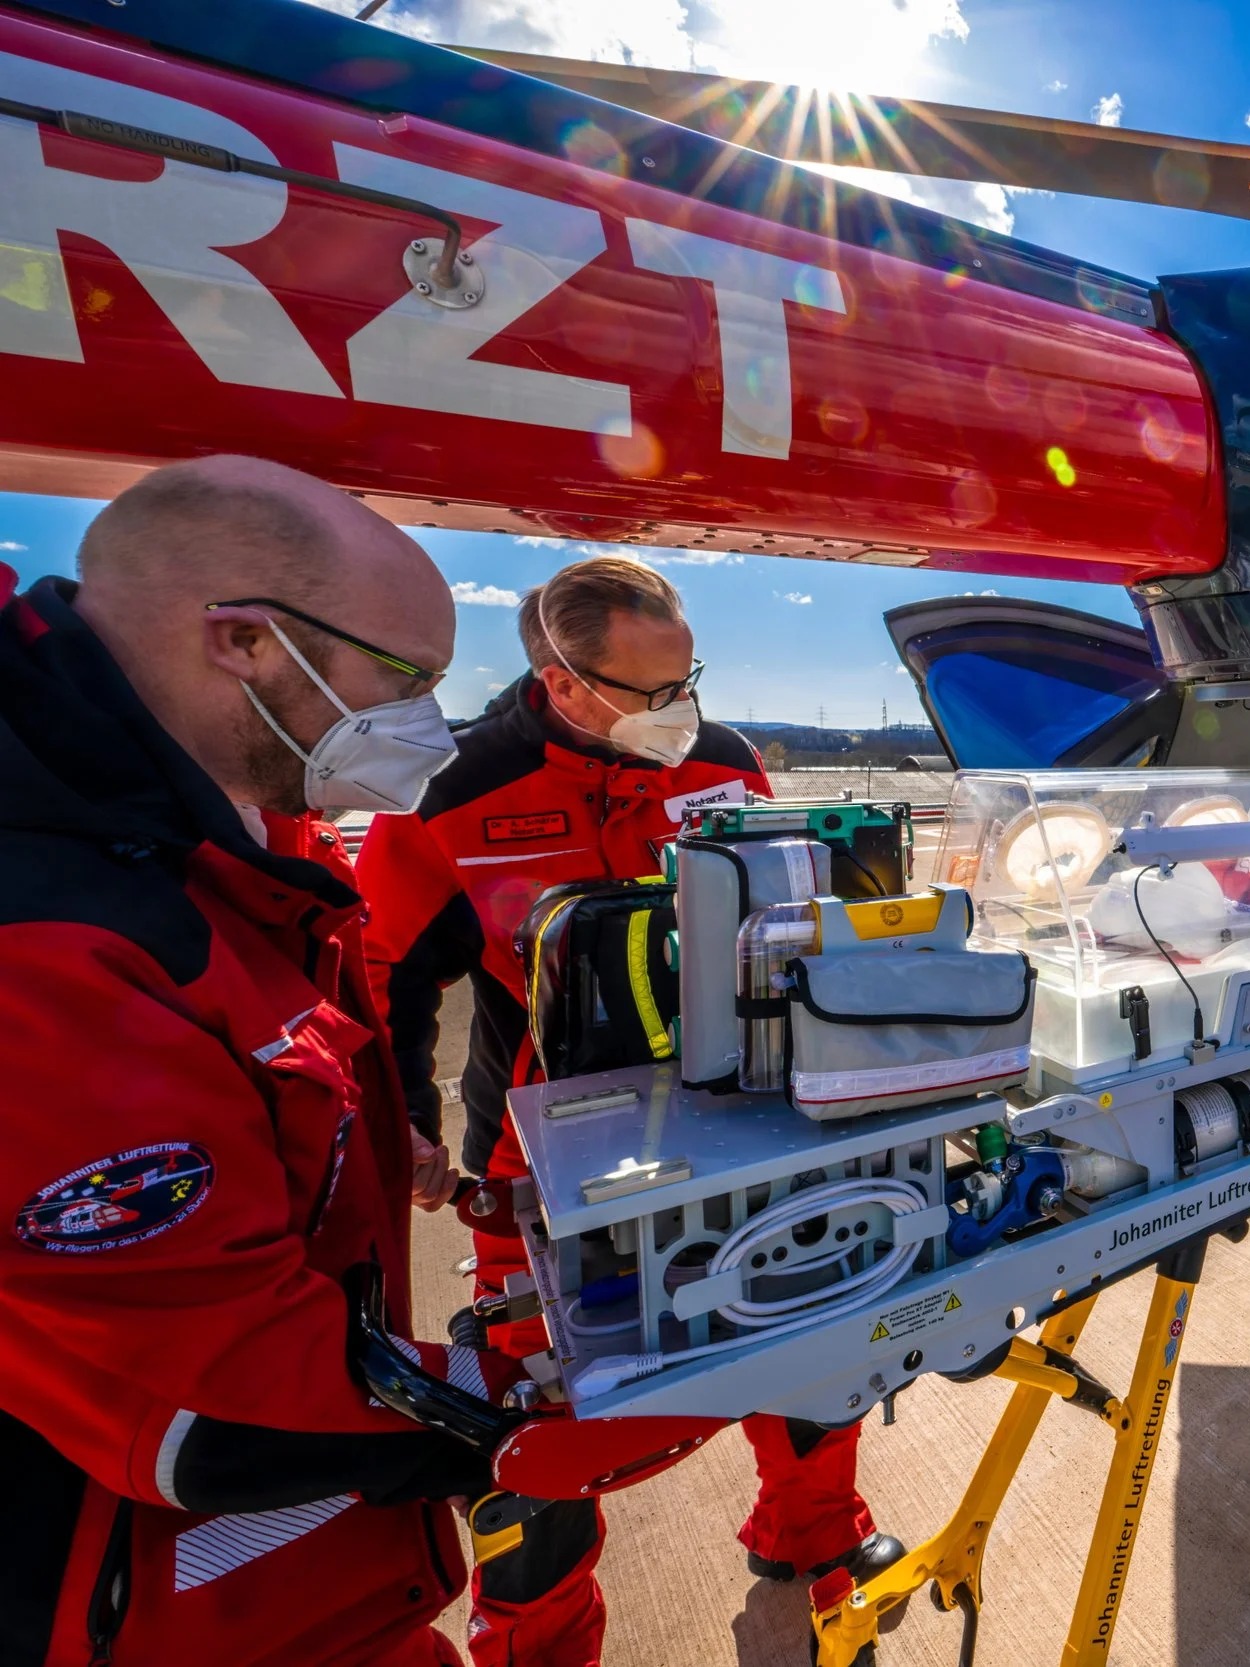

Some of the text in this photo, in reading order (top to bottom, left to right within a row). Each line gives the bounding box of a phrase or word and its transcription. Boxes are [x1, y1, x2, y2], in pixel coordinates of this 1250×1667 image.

[87, 118, 211, 158] NO HANDLING
[685, 790, 729, 808] Notarzt
[36, 1142, 191, 1200] JOHANNITER LUFTRETTUNG
[1110, 1200, 1204, 1251] Johanniter
[1092, 1377, 1172, 1649] Johanniter Luftrettung
